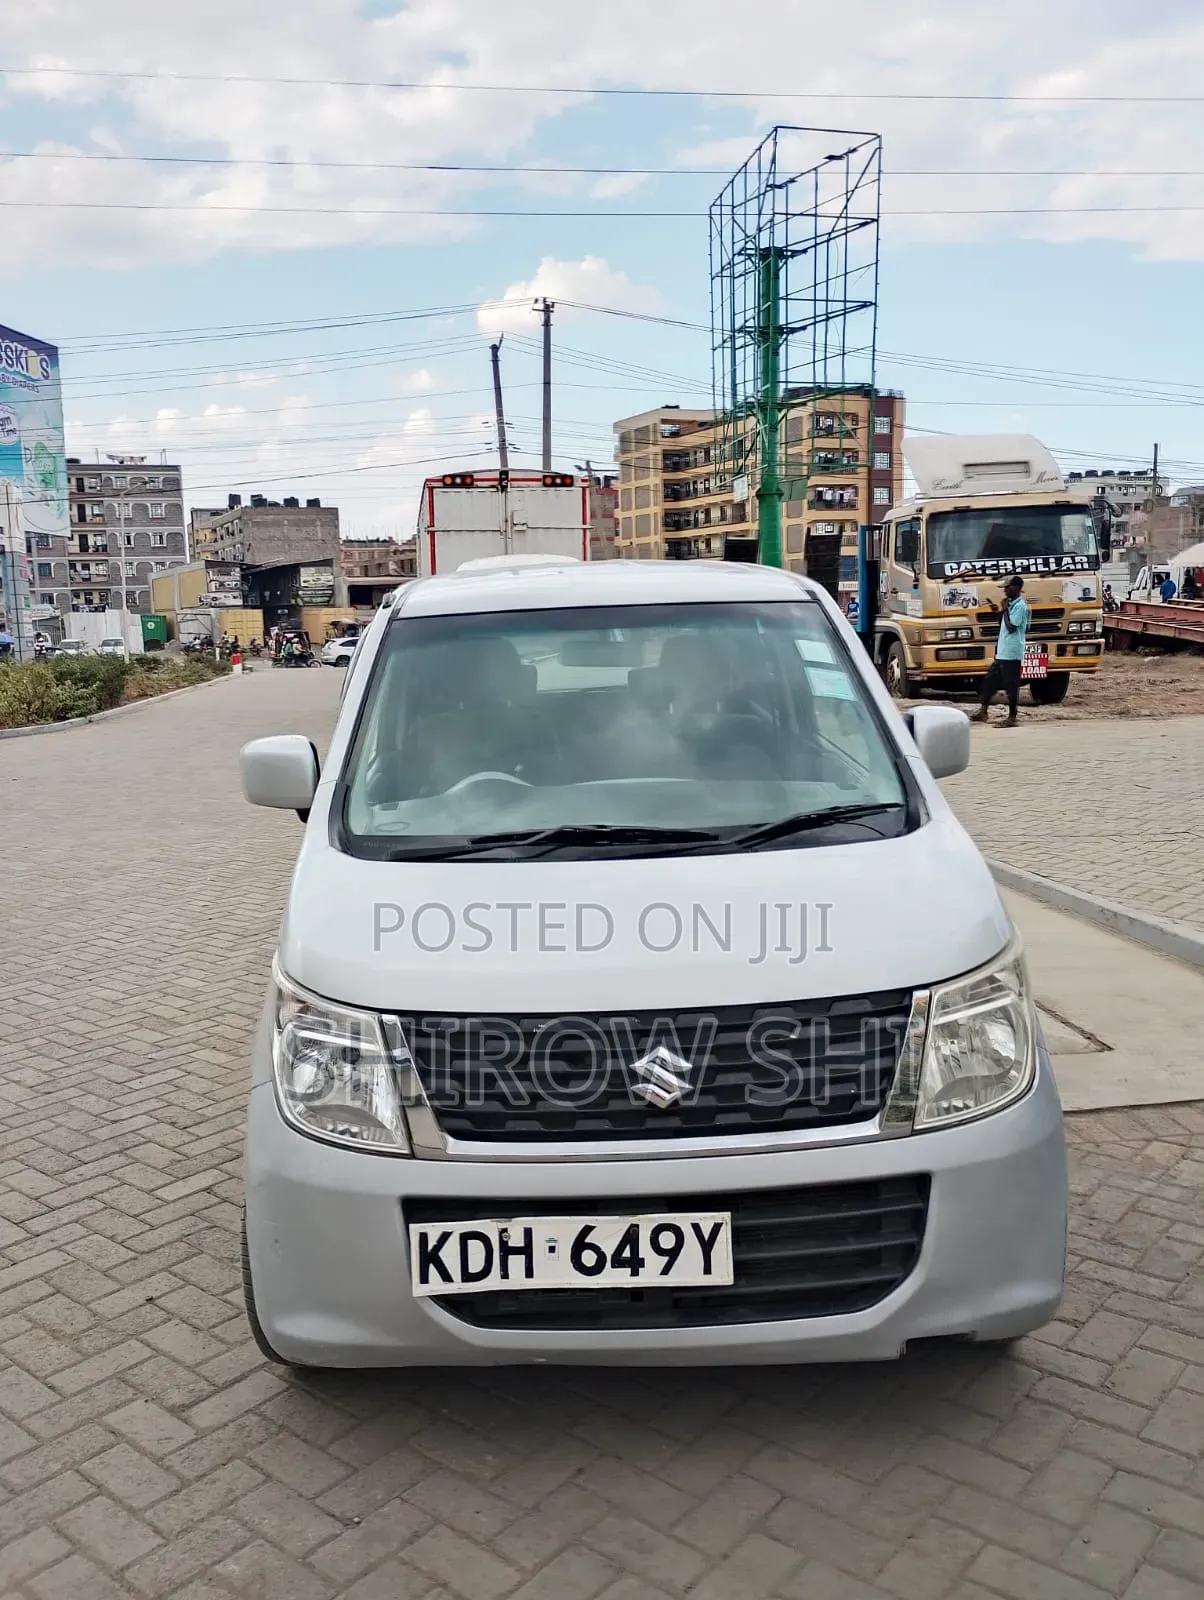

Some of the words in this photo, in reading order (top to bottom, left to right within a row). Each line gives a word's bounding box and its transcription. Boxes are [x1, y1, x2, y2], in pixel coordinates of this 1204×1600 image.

[944, 556, 1089, 577] CATERPILLAR
[418, 1226, 534, 1285] KDH
[569, 1222, 724, 1278] 649Y
